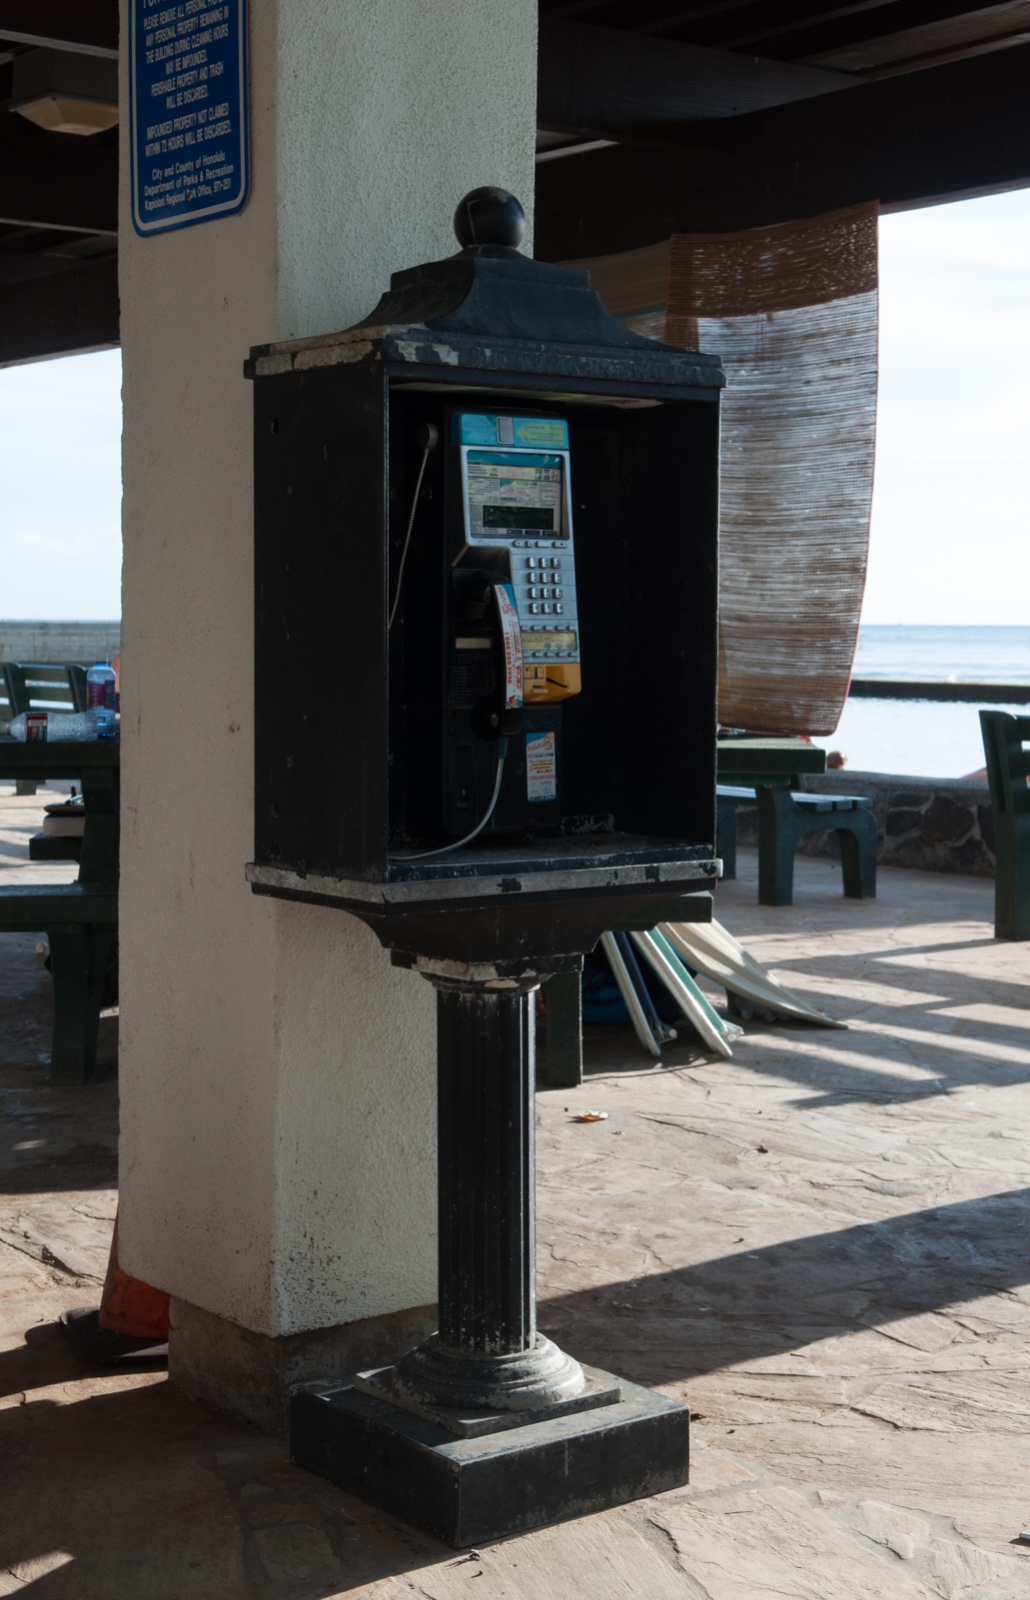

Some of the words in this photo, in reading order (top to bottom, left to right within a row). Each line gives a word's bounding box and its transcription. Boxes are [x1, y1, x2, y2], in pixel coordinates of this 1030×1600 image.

[144, 14, 158, 30] PLEASE
[160, 7, 176, 25] REMOVE
[177, 4, 185, 18] ALL
[146, 33, 154, 47] ANY
[155, 25, 176, 44] PERSONAL
[178, 17, 198, 36] PROPERTY
[200, 7, 223, 28] REMAINING
[224, 5, 229, 18] IN
[146, 50, 154, 64] THE
[155, 43, 174, 62] BUILDING
[175, 37, 190, 54] DURING
[191, 29, 212, 48] CLEANING
[213, 23, 228, 40] HOURS
[166, 60, 174, 75] MAY
[175, 58, 181, 72] BE
[182, 49, 208, 69] IMPOUNDED.
[151, 78, 176, 97] PERISHABLE
[177, 70, 198, 88] PROPERTY
[199, 66, 208, 81] AND
[209, 61, 224, 78] TRASH
[166, 95, 176, 110] WILL
[177, 92, 182, 107] BE
[184, 84, 209, 104] DISCARDED.
[147, 120, 172, 140] IMPOUNDED
[174, 112, 197, 131] PROPERTY
[198, 109, 208, 124] NOT
[208, 102, 229, 121] CLAIMED
[145, 140, 160, 158] WITHIN
[162, 140, 167, 152] 72
[168, 134, 184, 151] HOURS
[185, 132, 196, 146] WILL
[197, 128, 203, 142] BE
[205, 120, 232, 140] DISCARDED.
[144, 180, 174, 197] Department
[176, 176, 182, 188] of
[184, 173, 198, 186] Parks
[200, 170, 204, 182] &
[206, 164, 234, 180] Recreation
[152, 168, 162, 181] City
[164, 164, 174, 177] and
[176, 160, 194, 174] County
[196, 156, 202, 168] of
[203, 150, 225, 165] Honolulu
[145, 196, 165, 212] Kapiolani
[166, 192, 186, 206] Regional
[198, 184, 213, 197] Office,
